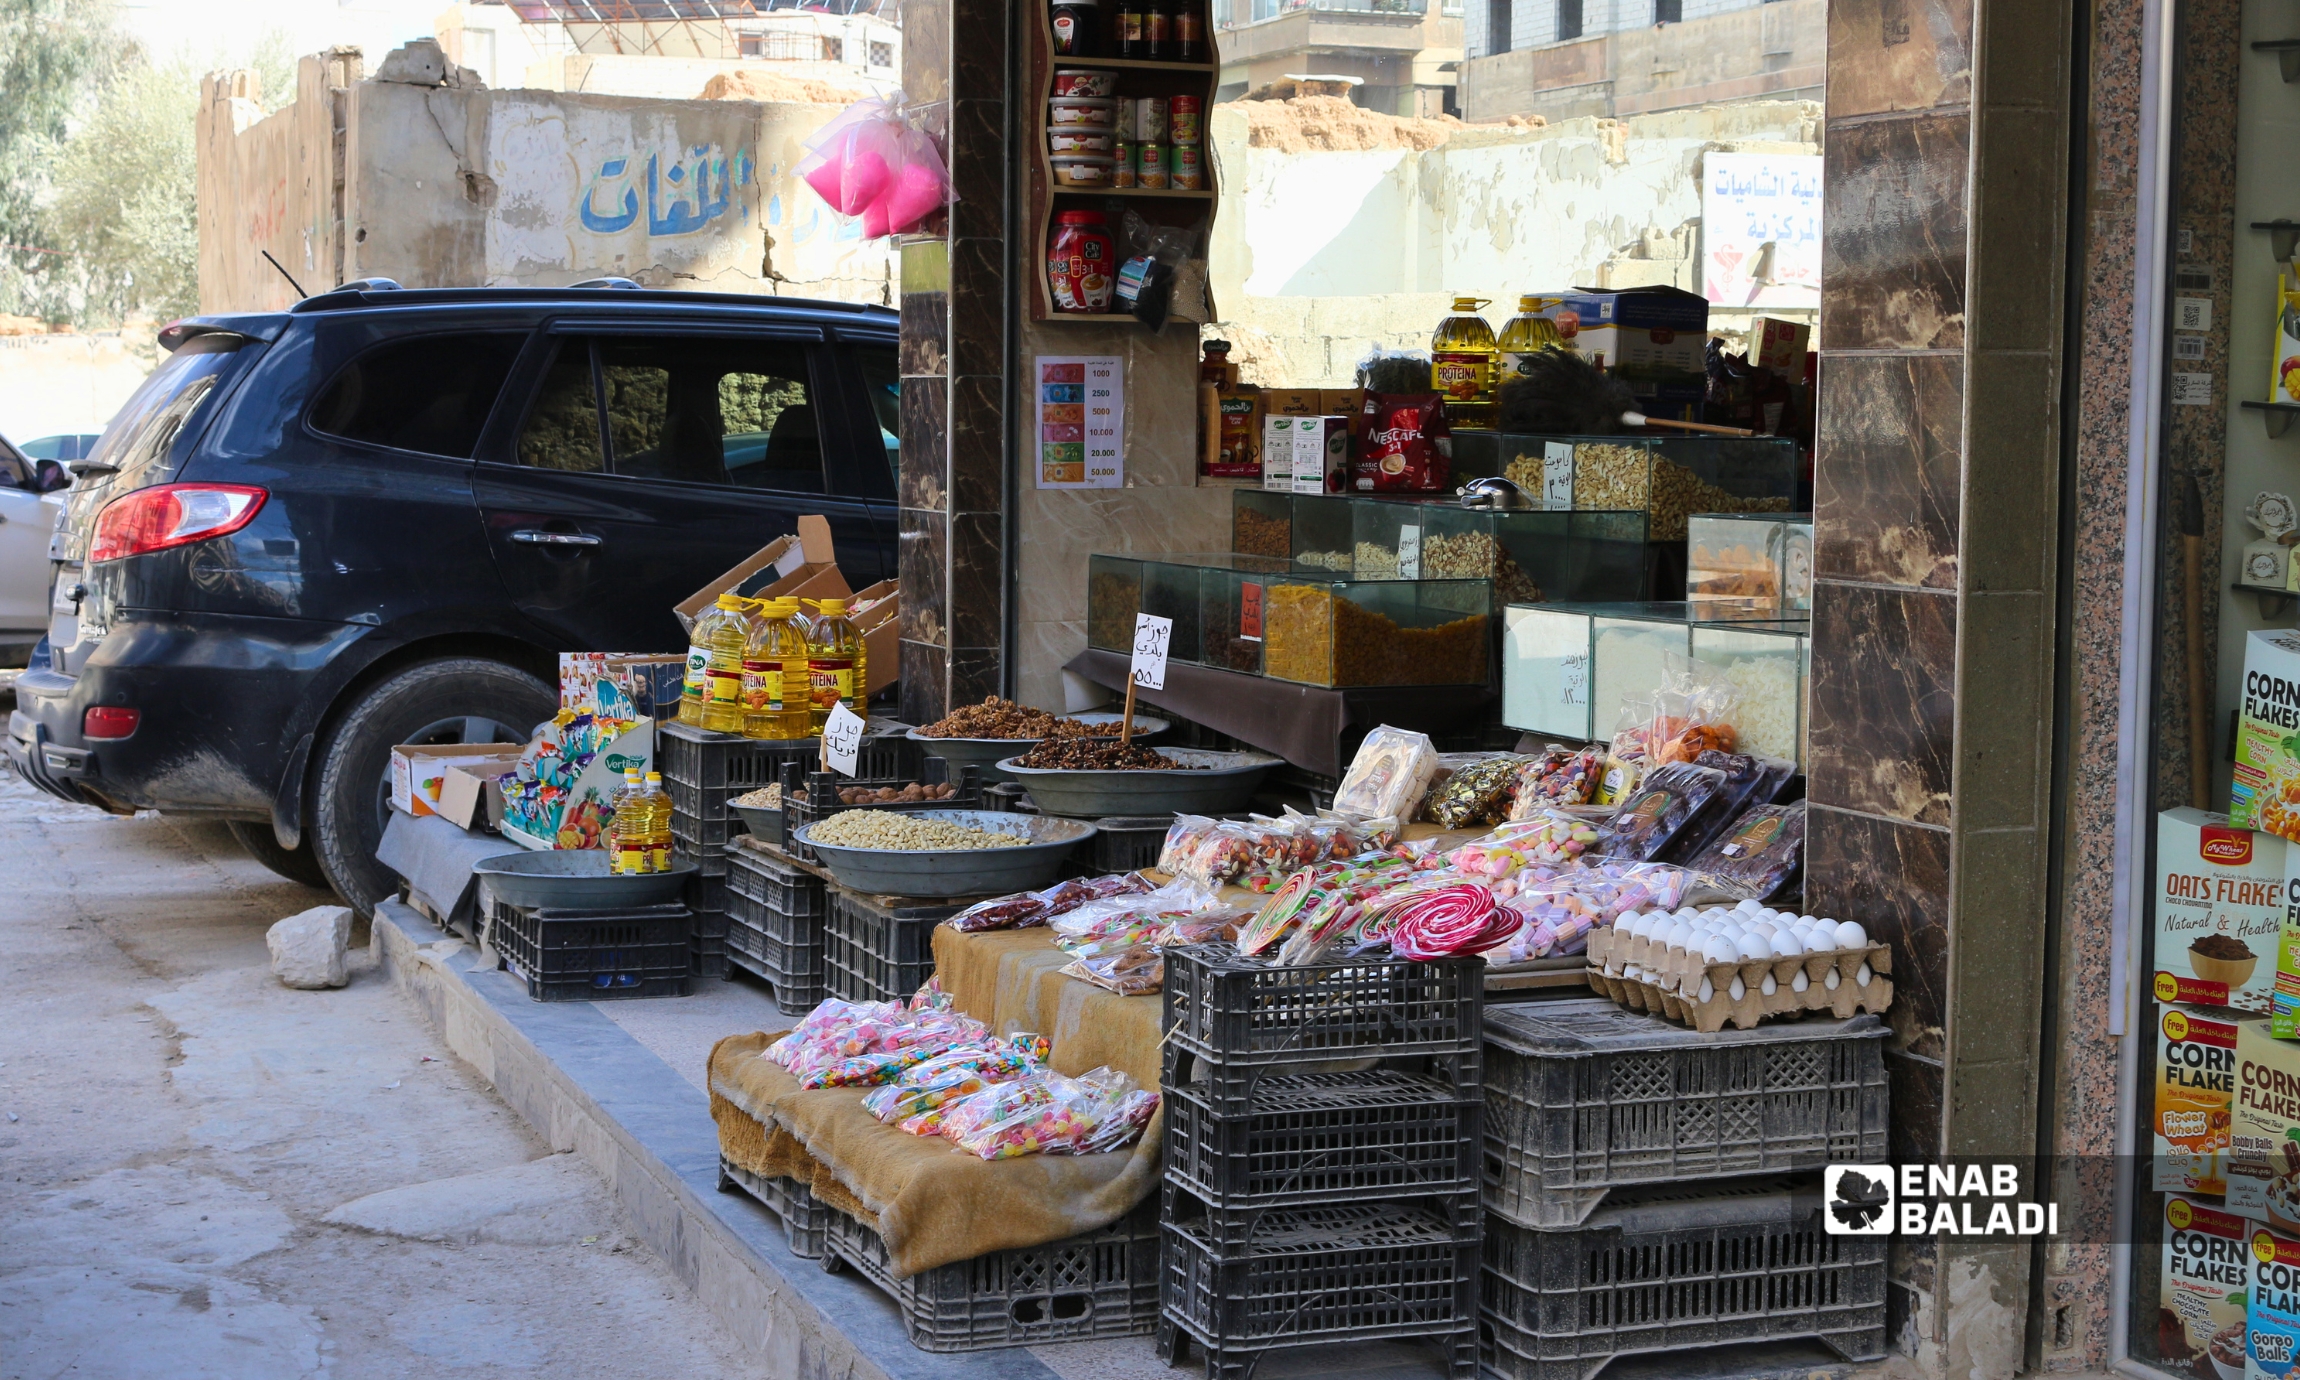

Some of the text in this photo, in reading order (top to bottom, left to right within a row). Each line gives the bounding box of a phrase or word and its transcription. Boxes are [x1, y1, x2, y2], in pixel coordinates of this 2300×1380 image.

[1715, 166, 1784, 204] الشاميات
[1086, 242, 1099, 250] City
[1438, 367, 1477, 382] PROTEINA
[1147, 625, 1168, 643] جوز
[1136, 641, 1162, 661] بلدي
[743, 673, 767, 688] OTEINA
[810, 673, 838, 687] OTEINA
[2247, 670, 2300, 708] CORN
[2245, 696, 2299, 730] FLAKES
[831, 716, 858, 742] جوز
[2247, 738, 2274, 756] HEALTHY
[606, 757, 640, 769] Vertika
[2249, 750, 2267, 764] CORN
[2167, 873, 2211, 900] OATS
[2166, 897, 2181, 905] CHOCO
[2164, 911, 2281, 937] Natural & Health
[2157, 981, 2174, 993] Free
[2167, 1019, 2184, 1032] Free
[2166, 1042, 2235, 1072] CORN
[2166, 1066, 2234, 1092] FLAKE
[2241, 1060, 2300, 1100] CORN
[2167, 1089, 2222, 1103] The Original Taste
[2165, 1112, 2204, 1124] Flower
[2240, 1110, 2284, 1129] The Original Taste
[2165, 1123, 2206, 1135] Wheat
[2232, 1136, 2273, 1149] Bobby Balls
[2238, 1148, 2267, 1162] Crunchy
[2171, 1208, 2188, 1221] Free
[2171, 1231, 2248, 1266] CORN
[2256, 1240, 2272, 1255] Free
[2171, 1255, 2247, 1286] FLAKES
[2256, 1262, 2300, 1293] CO
[2181, 1281, 2206, 1293] Original
[2207, 1286, 2223, 1295] Taste
[2172, 1297, 2210, 1317] CHOCOLATE
[2177, 1293, 2207, 1307] HEALTHY
[2256, 1286, 2300, 1315] FLAK
[2179, 1309, 2198, 1320] CORN
[2256, 1310, 2265, 1318] The
[2266, 1313, 2290, 1325] Original
[2251, 1332, 2293, 1347] Goreo
[2257, 1346, 2290, 1361] Balls
